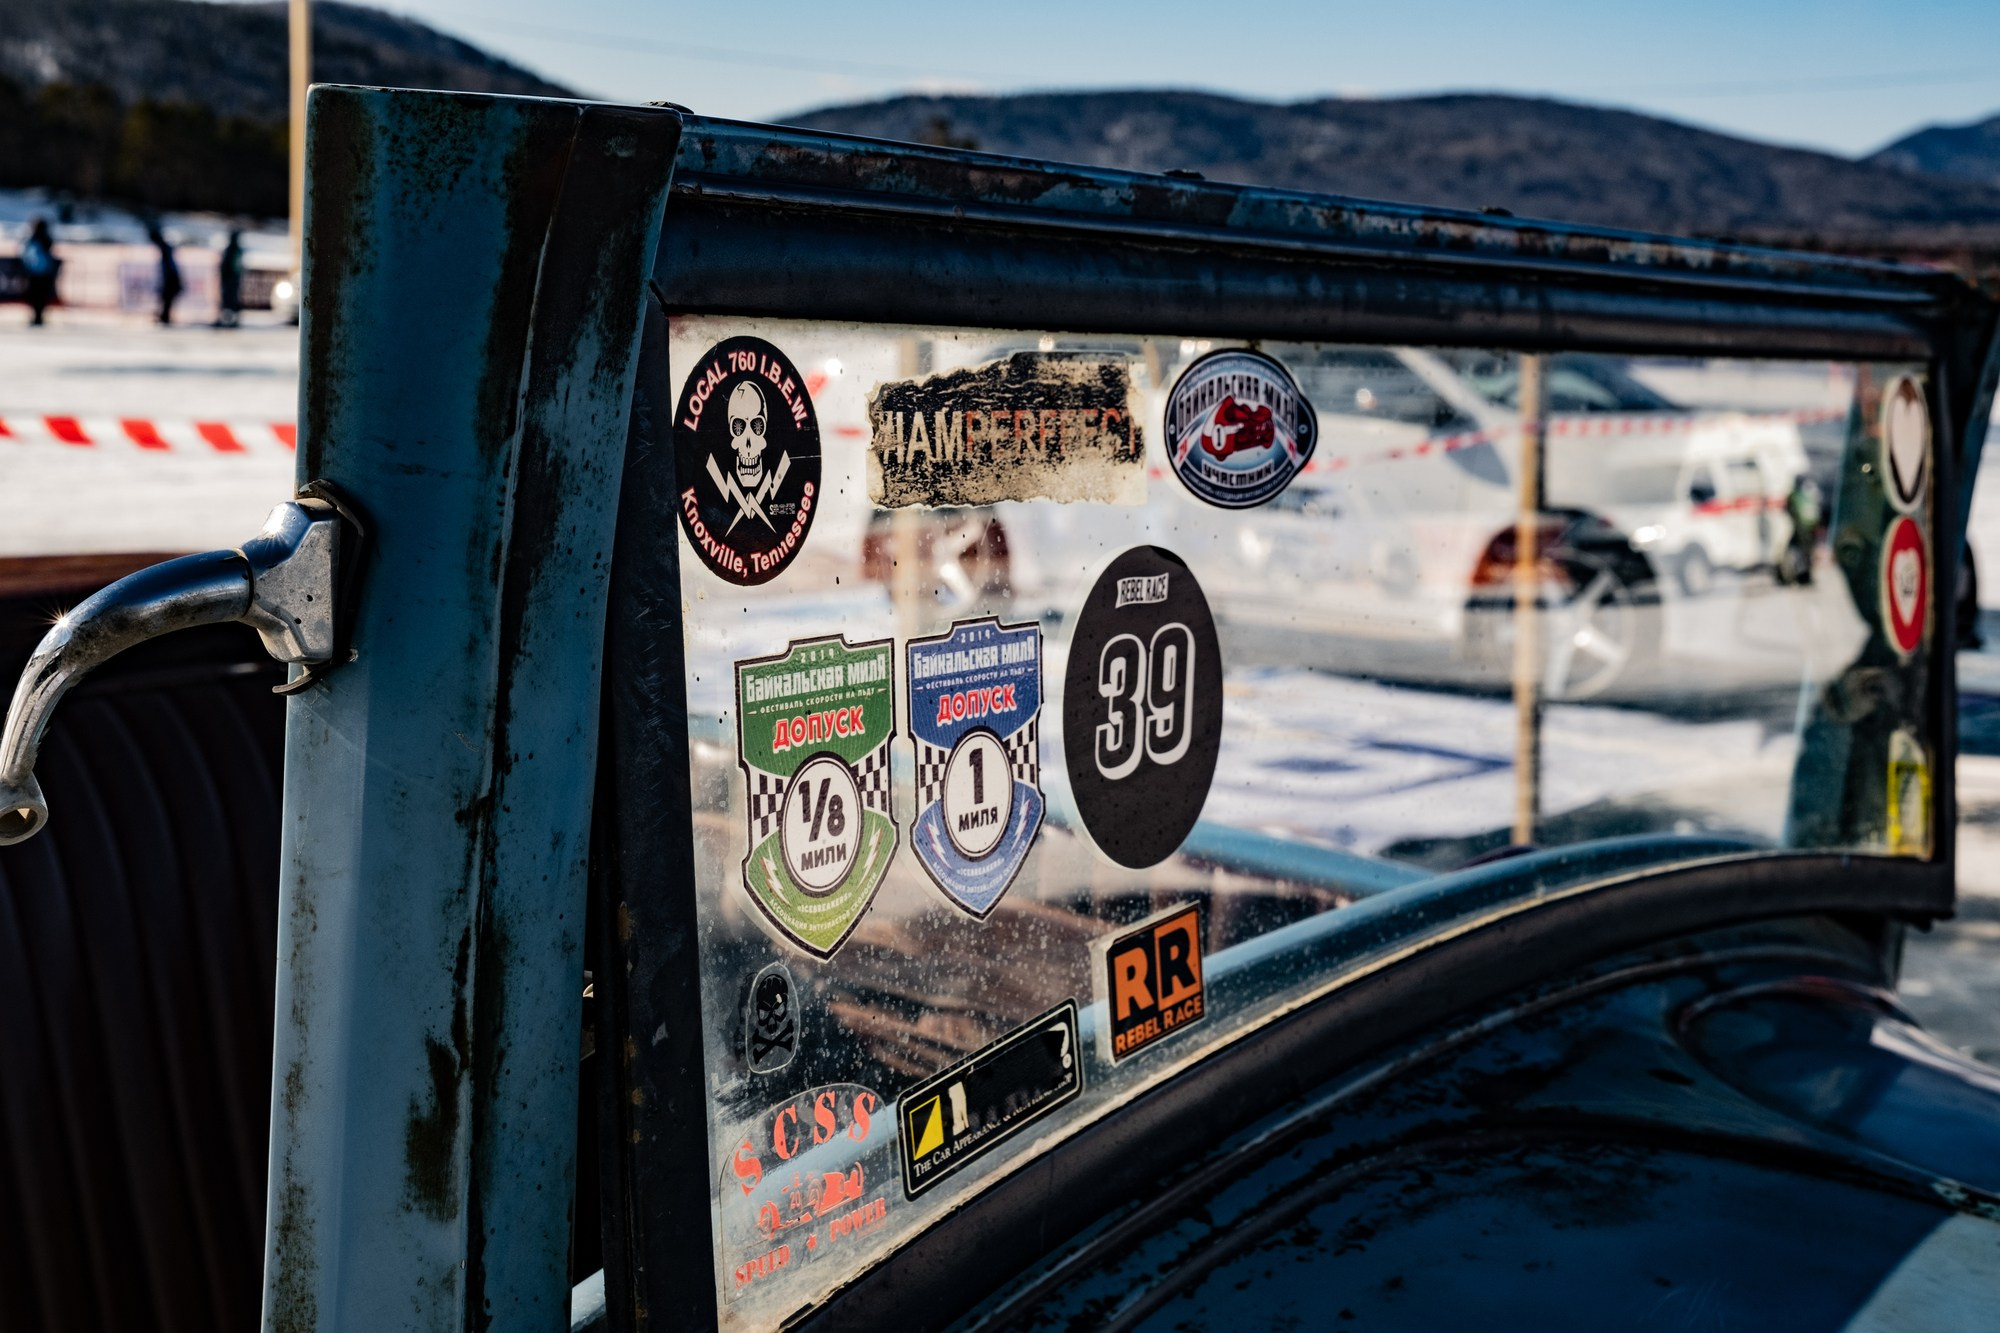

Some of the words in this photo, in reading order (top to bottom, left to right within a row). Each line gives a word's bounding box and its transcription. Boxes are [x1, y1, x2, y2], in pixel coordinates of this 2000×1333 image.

[684, 360, 728, 433] LOCAL
[728, 350, 757, 373] 760
[759, 354, 809, 430] I.B.E.W.
[681, 486, 749, 580] Knoxville,
[750, 481, 815, 575] Tennessee
[1120, 578, 1143, 604] REBEL
[1146, 575, 1167, 601] RACE
[805, 693, 843, 706] СКОРОСТИ
[937, 683, 1017, 726] ДОПУСК
[1095, 622, 1196, 780] 39
[773, 704, 865, 754] ДОПУСК
[969, 747, 984, 805] 1
[798, 777, 846, 843] 1/8
[958, 805, 999, 832] МИЛЯ
[801, 843, 847, 871] МИЛИ
[1114, 927, 1197, 1021] RR
[1115, 1016, 1161, 1053] REBEL
[1163, 995, 1202, 1029] RACE
[829, 1196, 887, 1242] POWER
